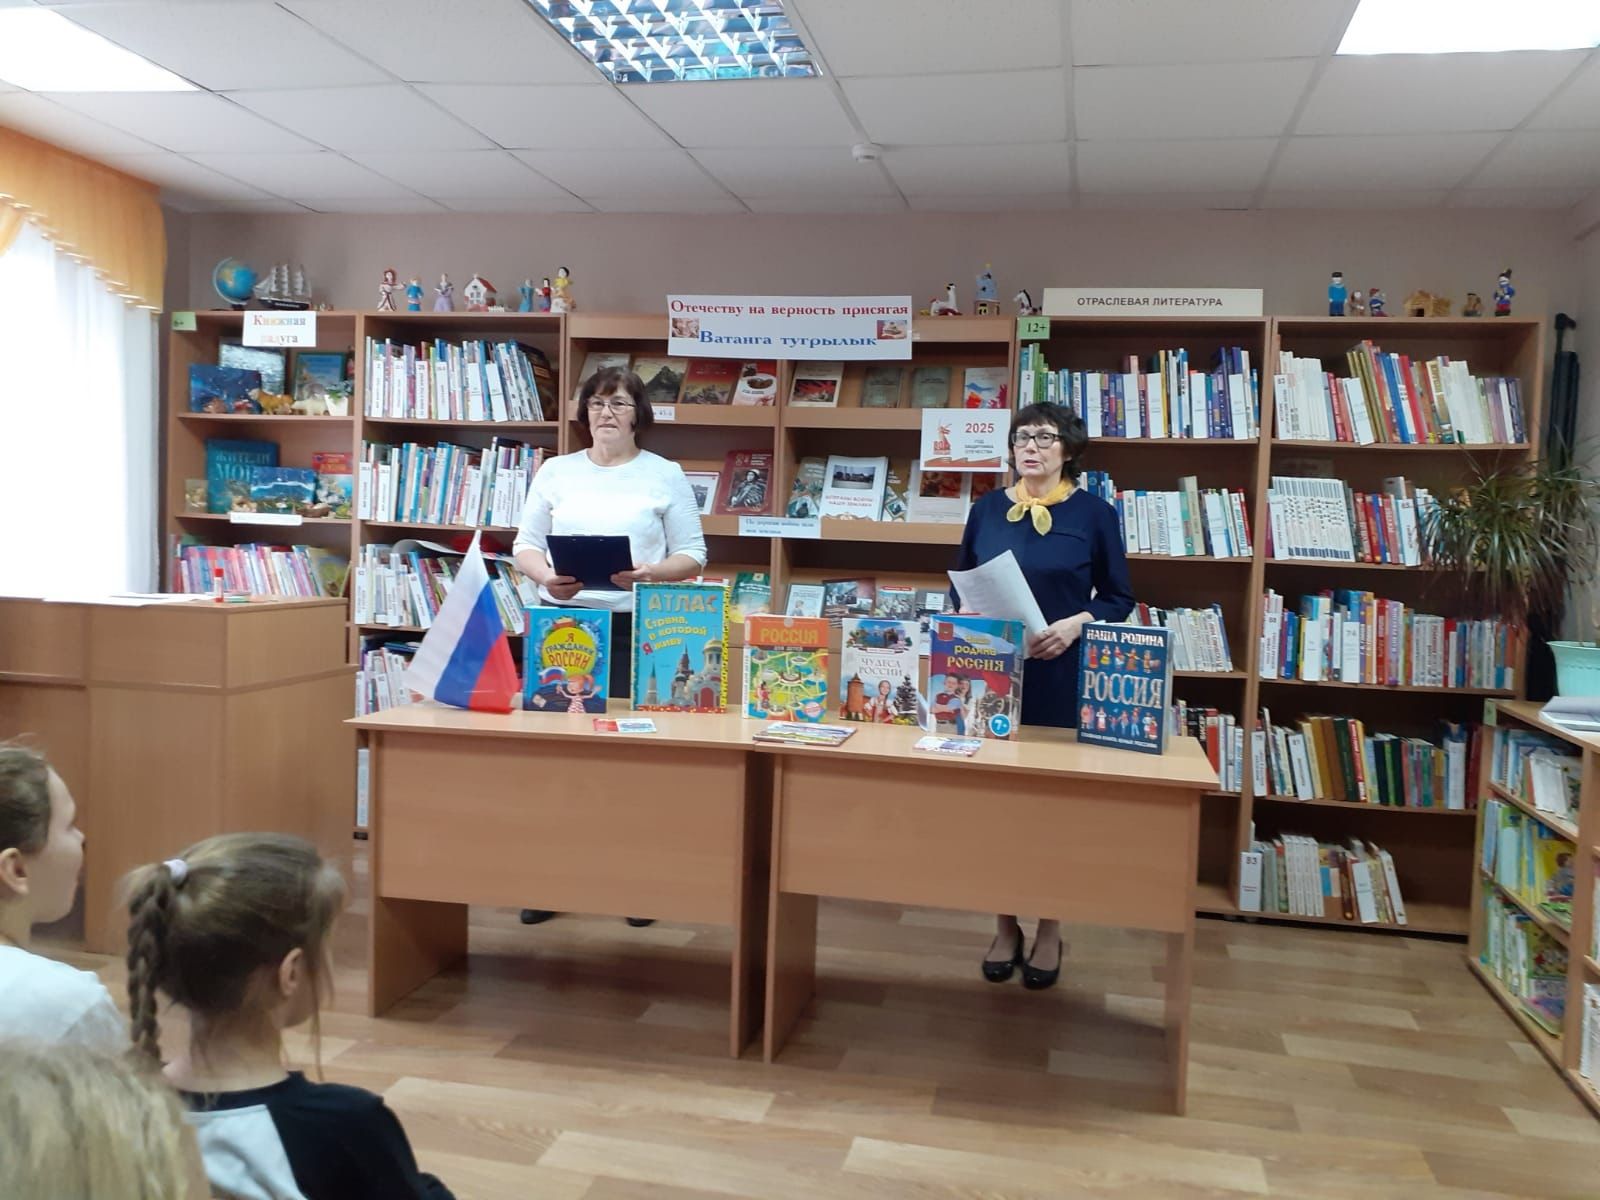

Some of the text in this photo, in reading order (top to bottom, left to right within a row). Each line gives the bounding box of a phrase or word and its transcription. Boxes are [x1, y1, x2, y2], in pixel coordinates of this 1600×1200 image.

[671, 300, 742, 317] Отечеству
[771, 306, 836, 317] верность
[842, 306, 908, 317] присягая
[1077, 297, 1223, 306] ОТРАСЛЕВАЯ ЛИТЕРАТУРА
[253, 314, 306, 326] Книжная
[1027, 322, 1047, 333] 12+
[700, 331, 772, 345] Ватанга
[965, 423, 995, 433] 2025
[648, 592, 718, 614] АТЛАС
[645, 615, 688, 630] Страна,
[565, 632, 574, 642] Я
[658, 626, 707, 637] которой
[760, 628, 818, 644] РОССИЯ
[1087, 629, 1164, 648] НАША РОДИНА
[548, 651, 591, 670] РОССИИ
[861, 657, 901, 667] ЧУДЕСА
[947, 656, 1005, 672] РОССИЯ
[859, 667, 903, 677] РОССИИ
[1082, 670, 1164, 710] РОССИЯ
